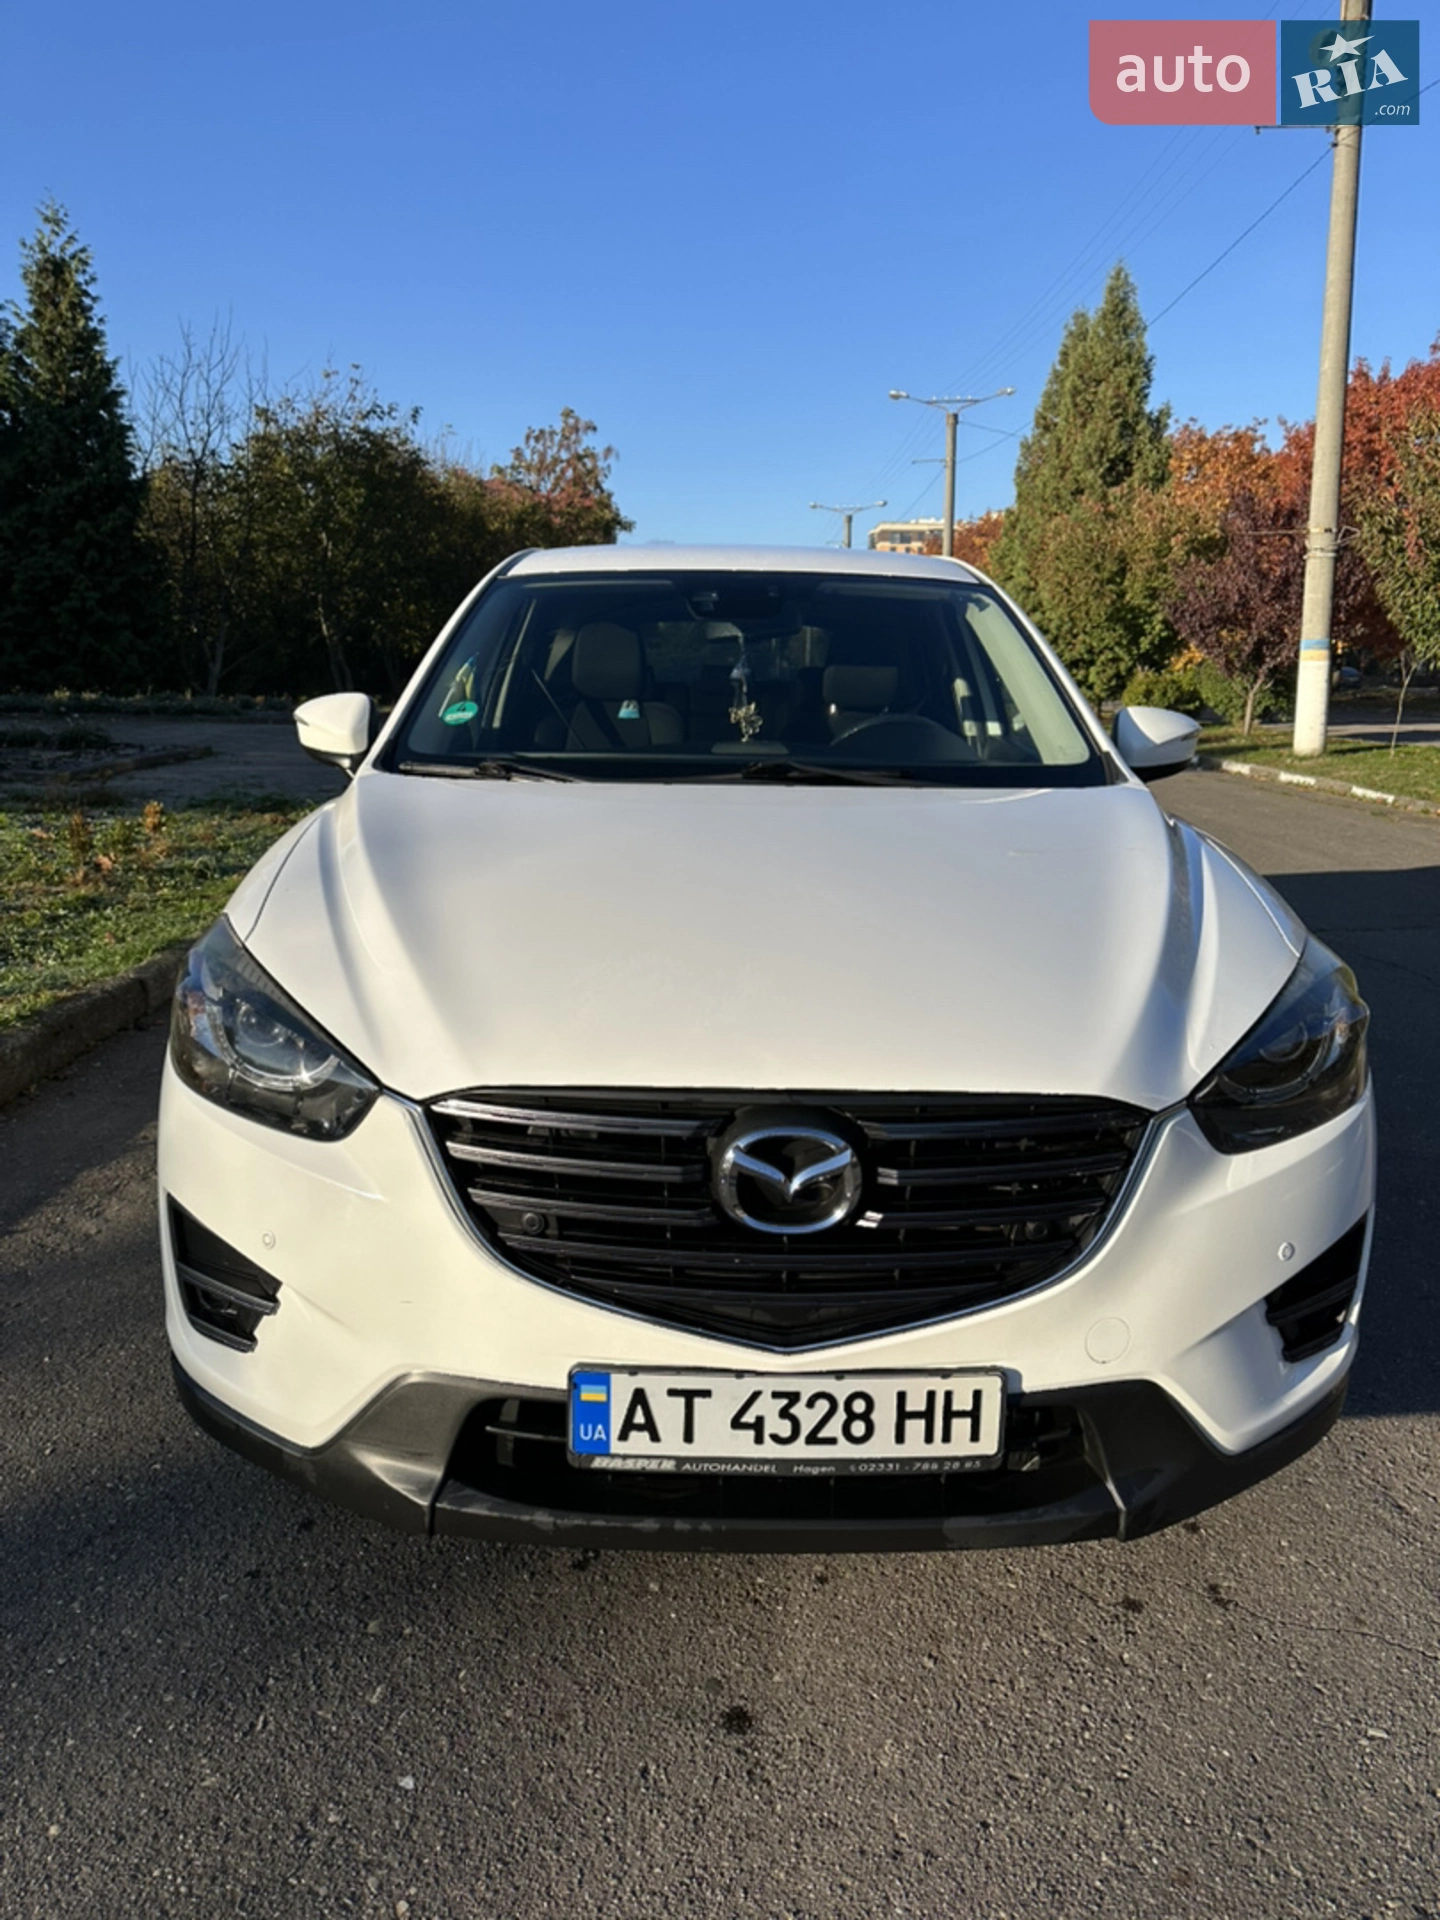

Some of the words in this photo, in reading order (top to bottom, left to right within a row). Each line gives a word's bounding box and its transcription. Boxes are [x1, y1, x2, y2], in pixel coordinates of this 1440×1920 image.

[617, 1387, 712, 1444] AT
[730, 1389, 875, 1445] 4328
[894, 1388, 983, 1444] HH
[579, 1423, 607, 1442] UA
[682, 1462, 777, 1473] AUTOHANDEL
[793, 1463, 836, 1475] Hagen
[858, 1463, 900, 1473] 02331
